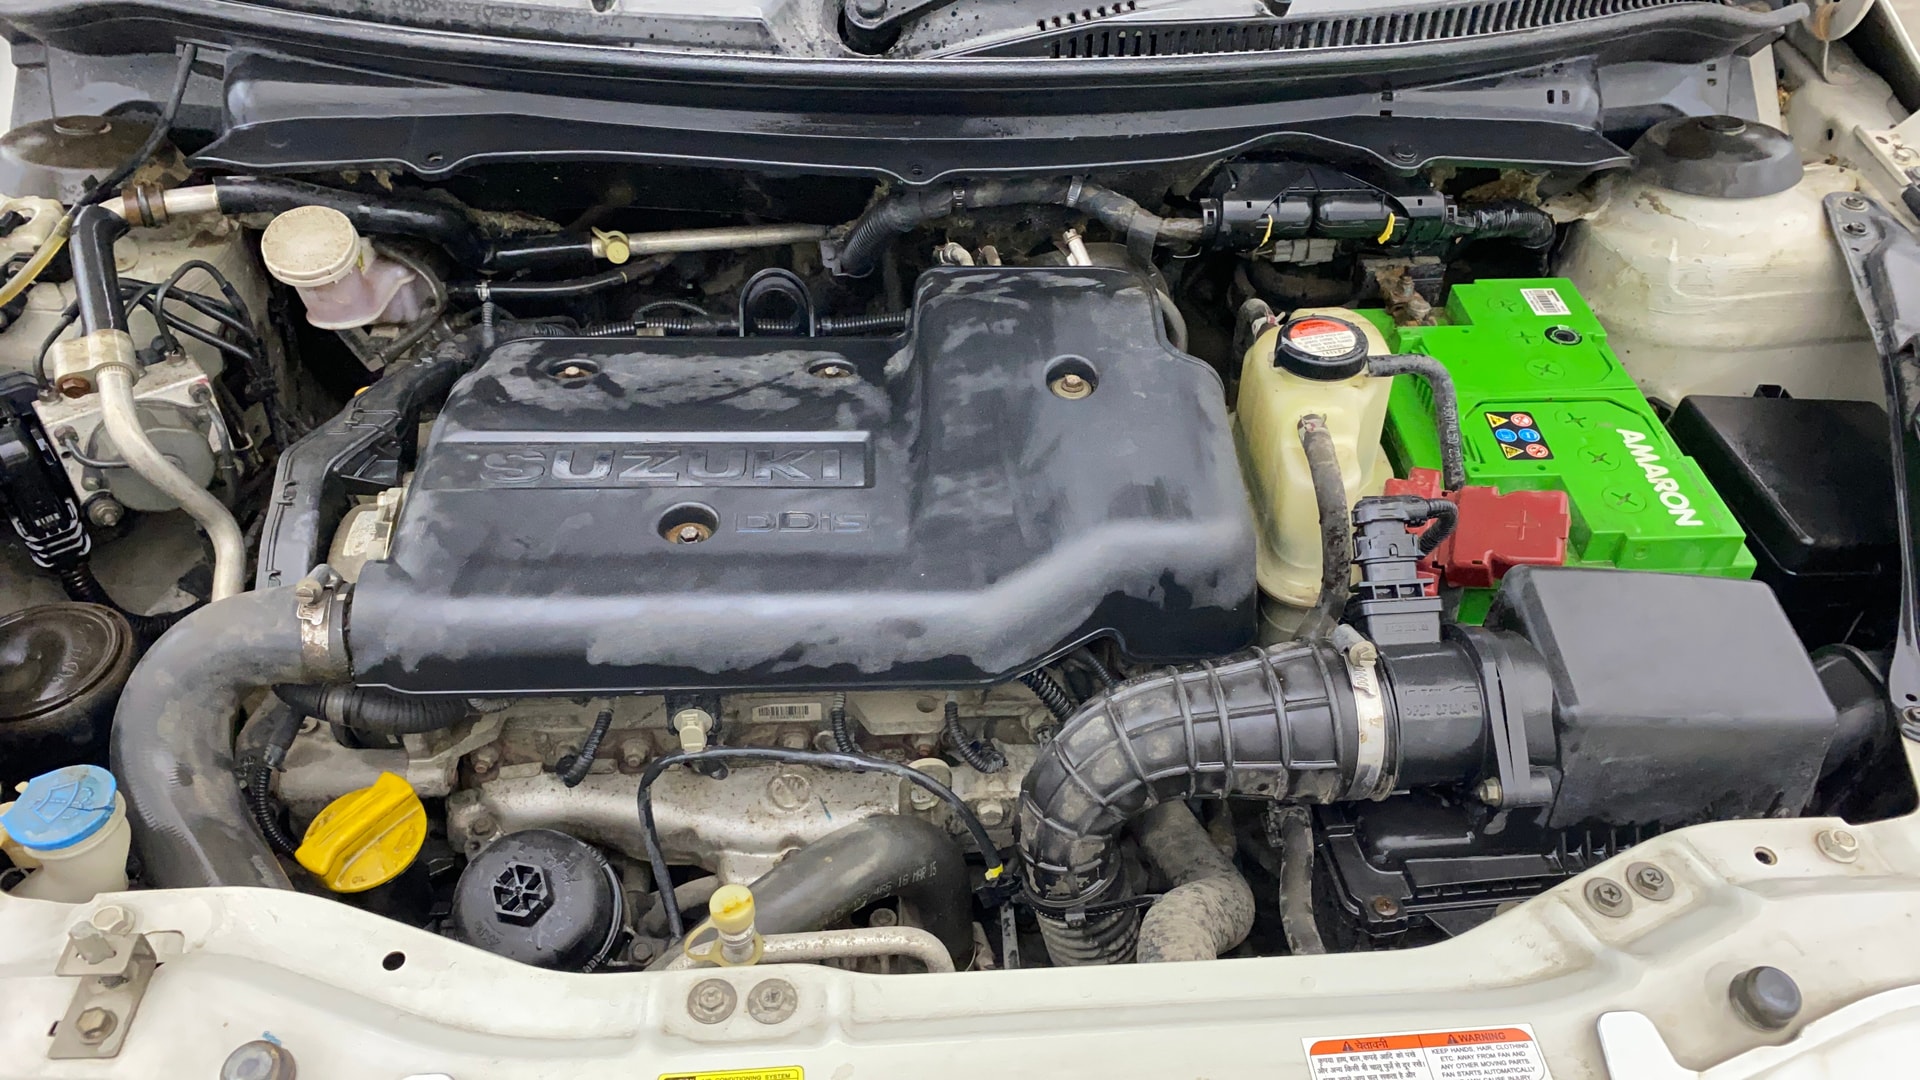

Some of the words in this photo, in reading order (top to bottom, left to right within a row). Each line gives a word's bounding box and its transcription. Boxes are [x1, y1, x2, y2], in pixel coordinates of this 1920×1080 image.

[480, 449, 842, 482] SUZUKI
[1616, 428, 1704, 526] AMARON
[1459, 1032, 1506, 1042] WARNING
[1354, 1037, 1388, 1050] चेतावनी
[1455, 1061, 1479, 1069] OTHER
[1480, 1059, 1507, 1067] MOVING
[1456, 1069, 1482, 1077] STARTS
[1483, 1066, 1535, 1075] AUTOMATICALLY
